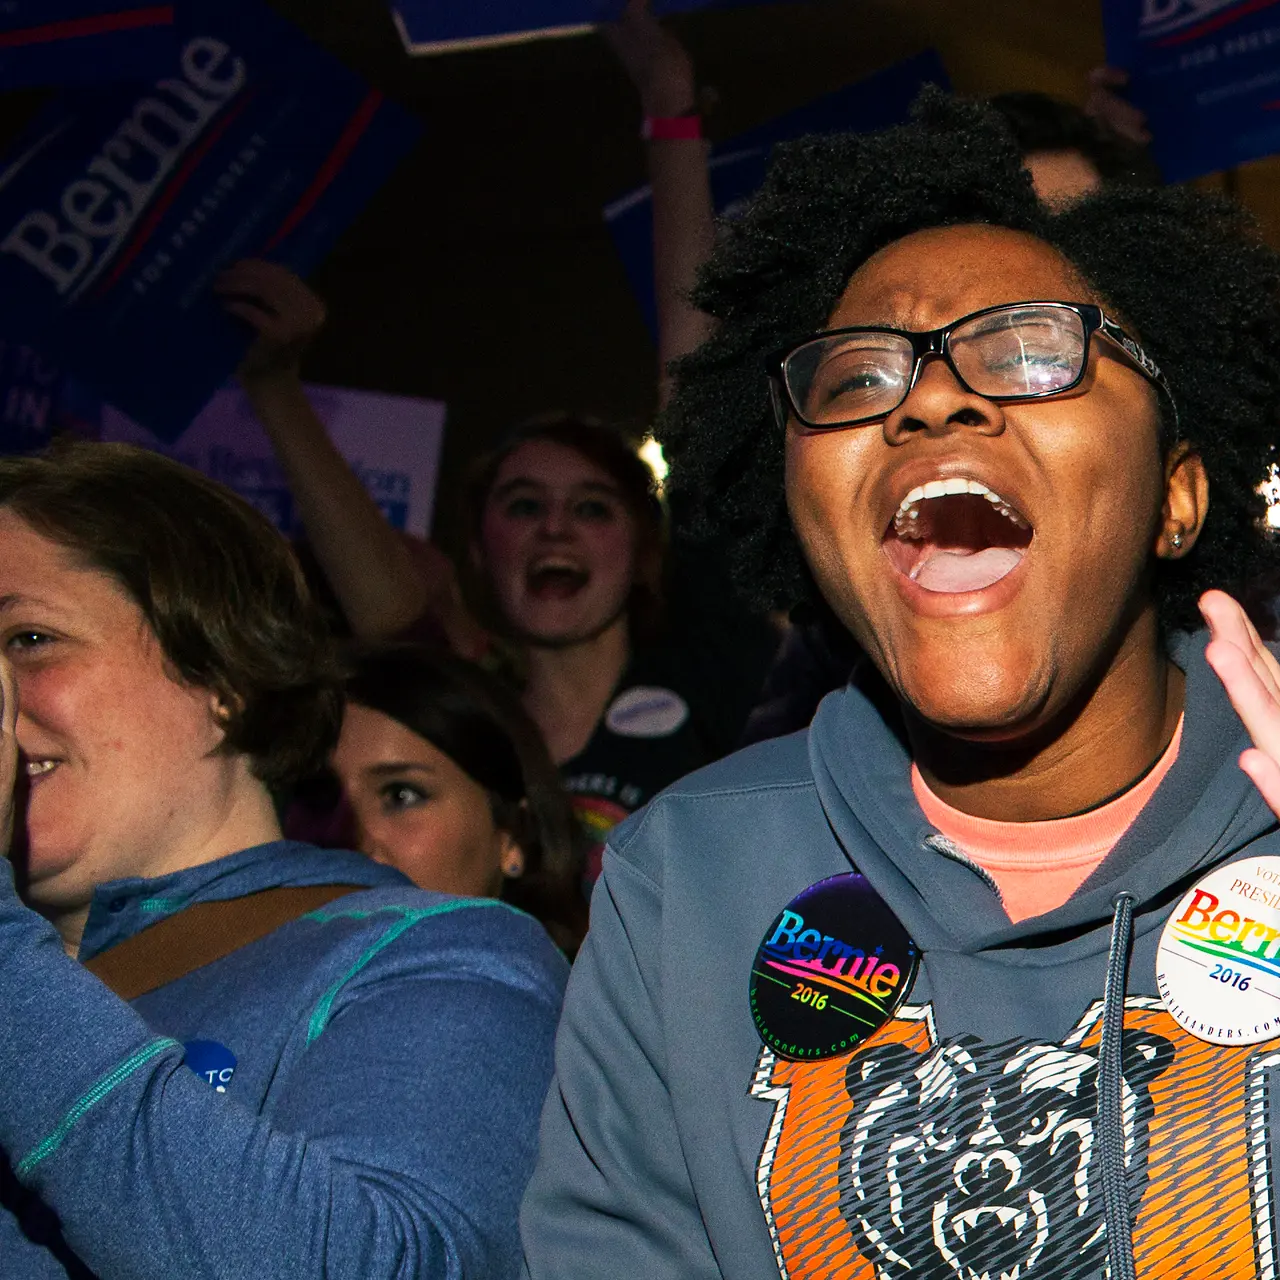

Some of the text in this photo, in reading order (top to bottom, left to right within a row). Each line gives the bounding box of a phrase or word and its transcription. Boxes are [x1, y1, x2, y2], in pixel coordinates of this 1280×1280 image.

[0, 34, 248, 295] Bernie
[766, 909, 901, 999] Bernie
[1208, 963, 1252, 992] 2016
[750, 988, 860, 1056] berniesanders.com
[790, 983, 829, 1011] 2016
